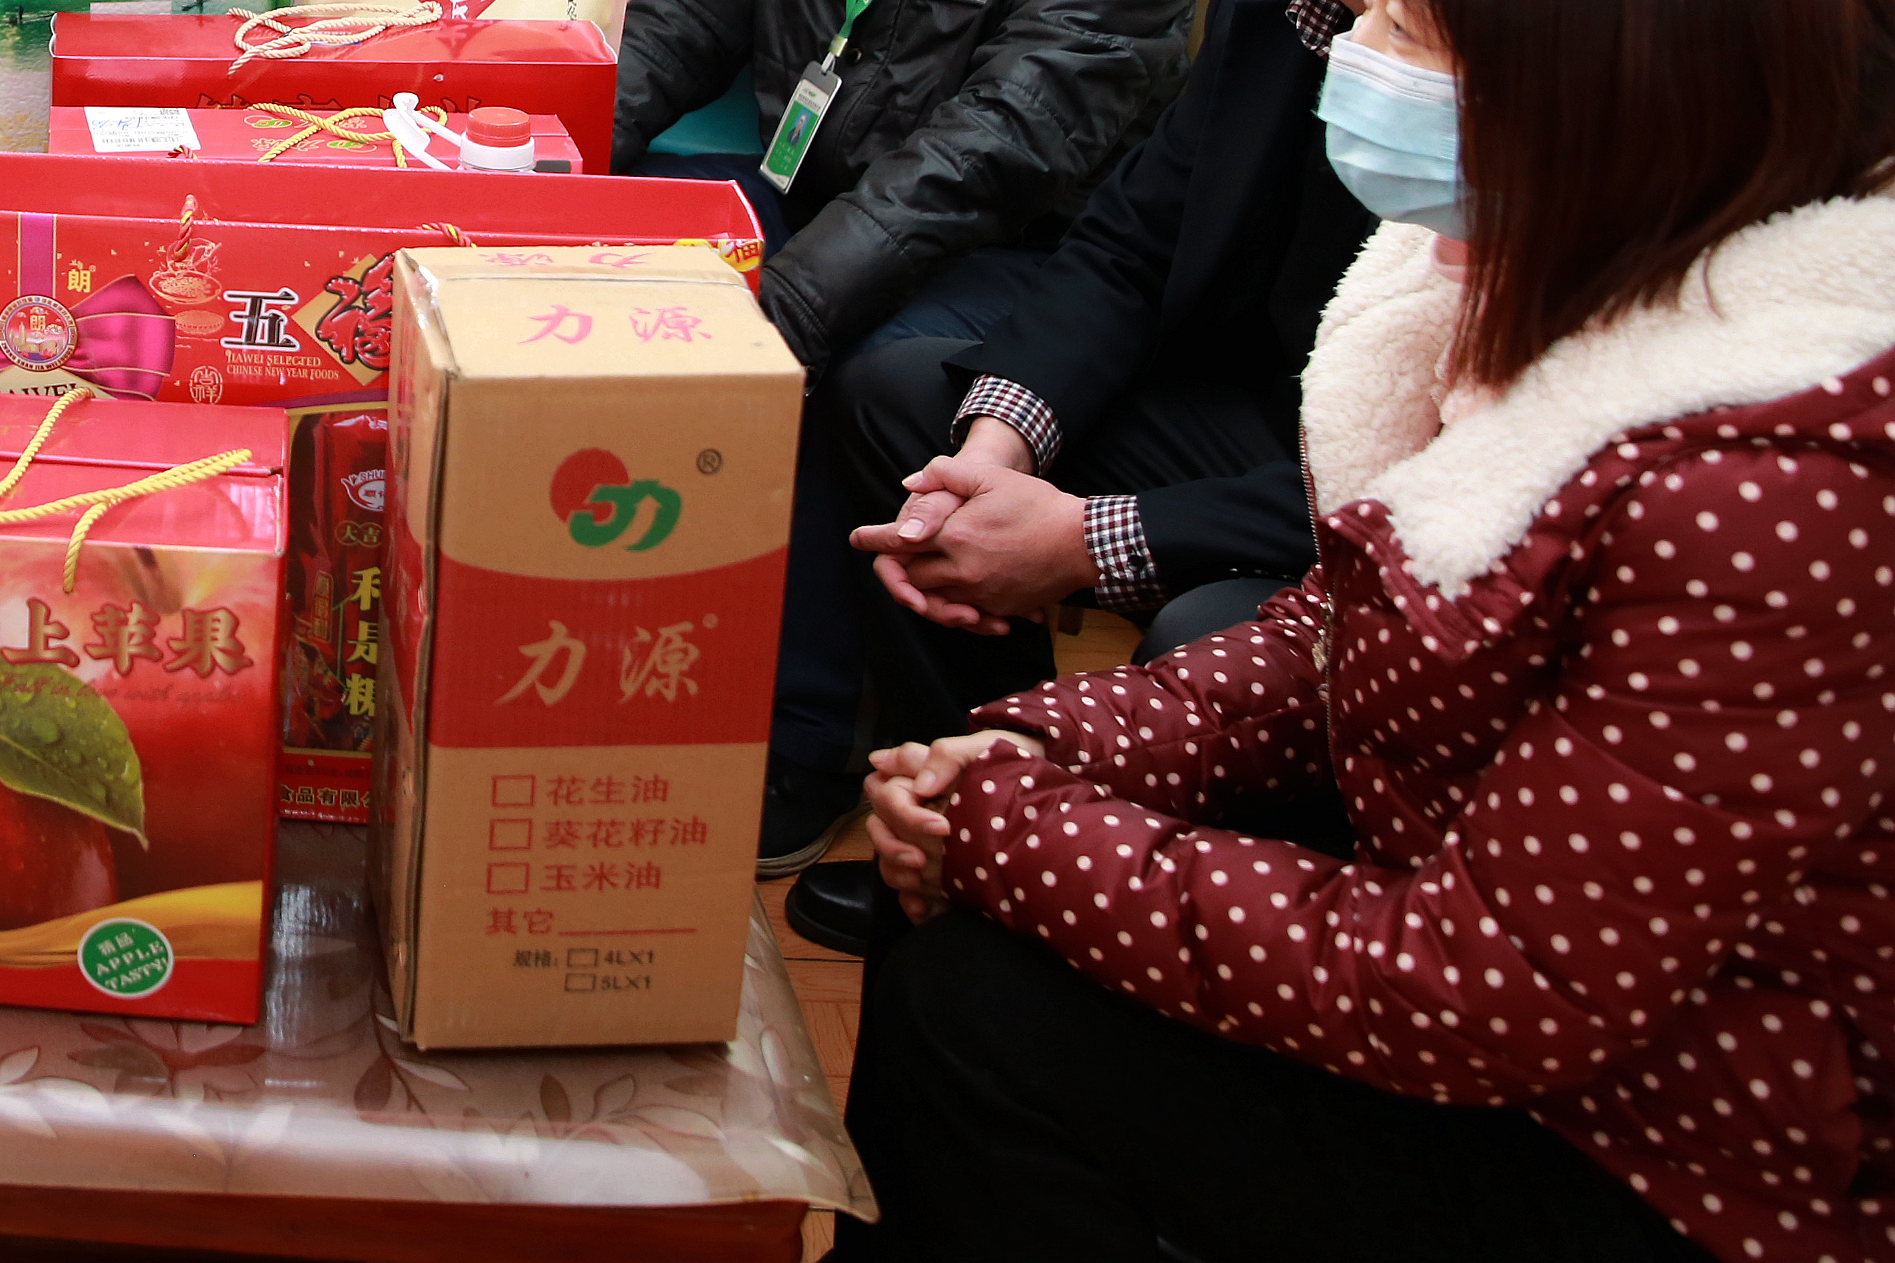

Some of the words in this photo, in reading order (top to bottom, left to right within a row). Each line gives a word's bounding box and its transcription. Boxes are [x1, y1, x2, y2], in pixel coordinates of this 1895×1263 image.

[227, 365, 263, 376] CHINESE
[265, 367, 284, 378] NEW
[286, 368, 308, 378] YEAR
[310, 369, 339, 380] FOODS
[493, 619, 701, 707] 力源
[546, 774, 669, 806] 花生油
[543, 815, 708, 849] 葵花籽油
[540, 861, 661, 892] 玉米油
[97, 940, 164, 976] APPLE
